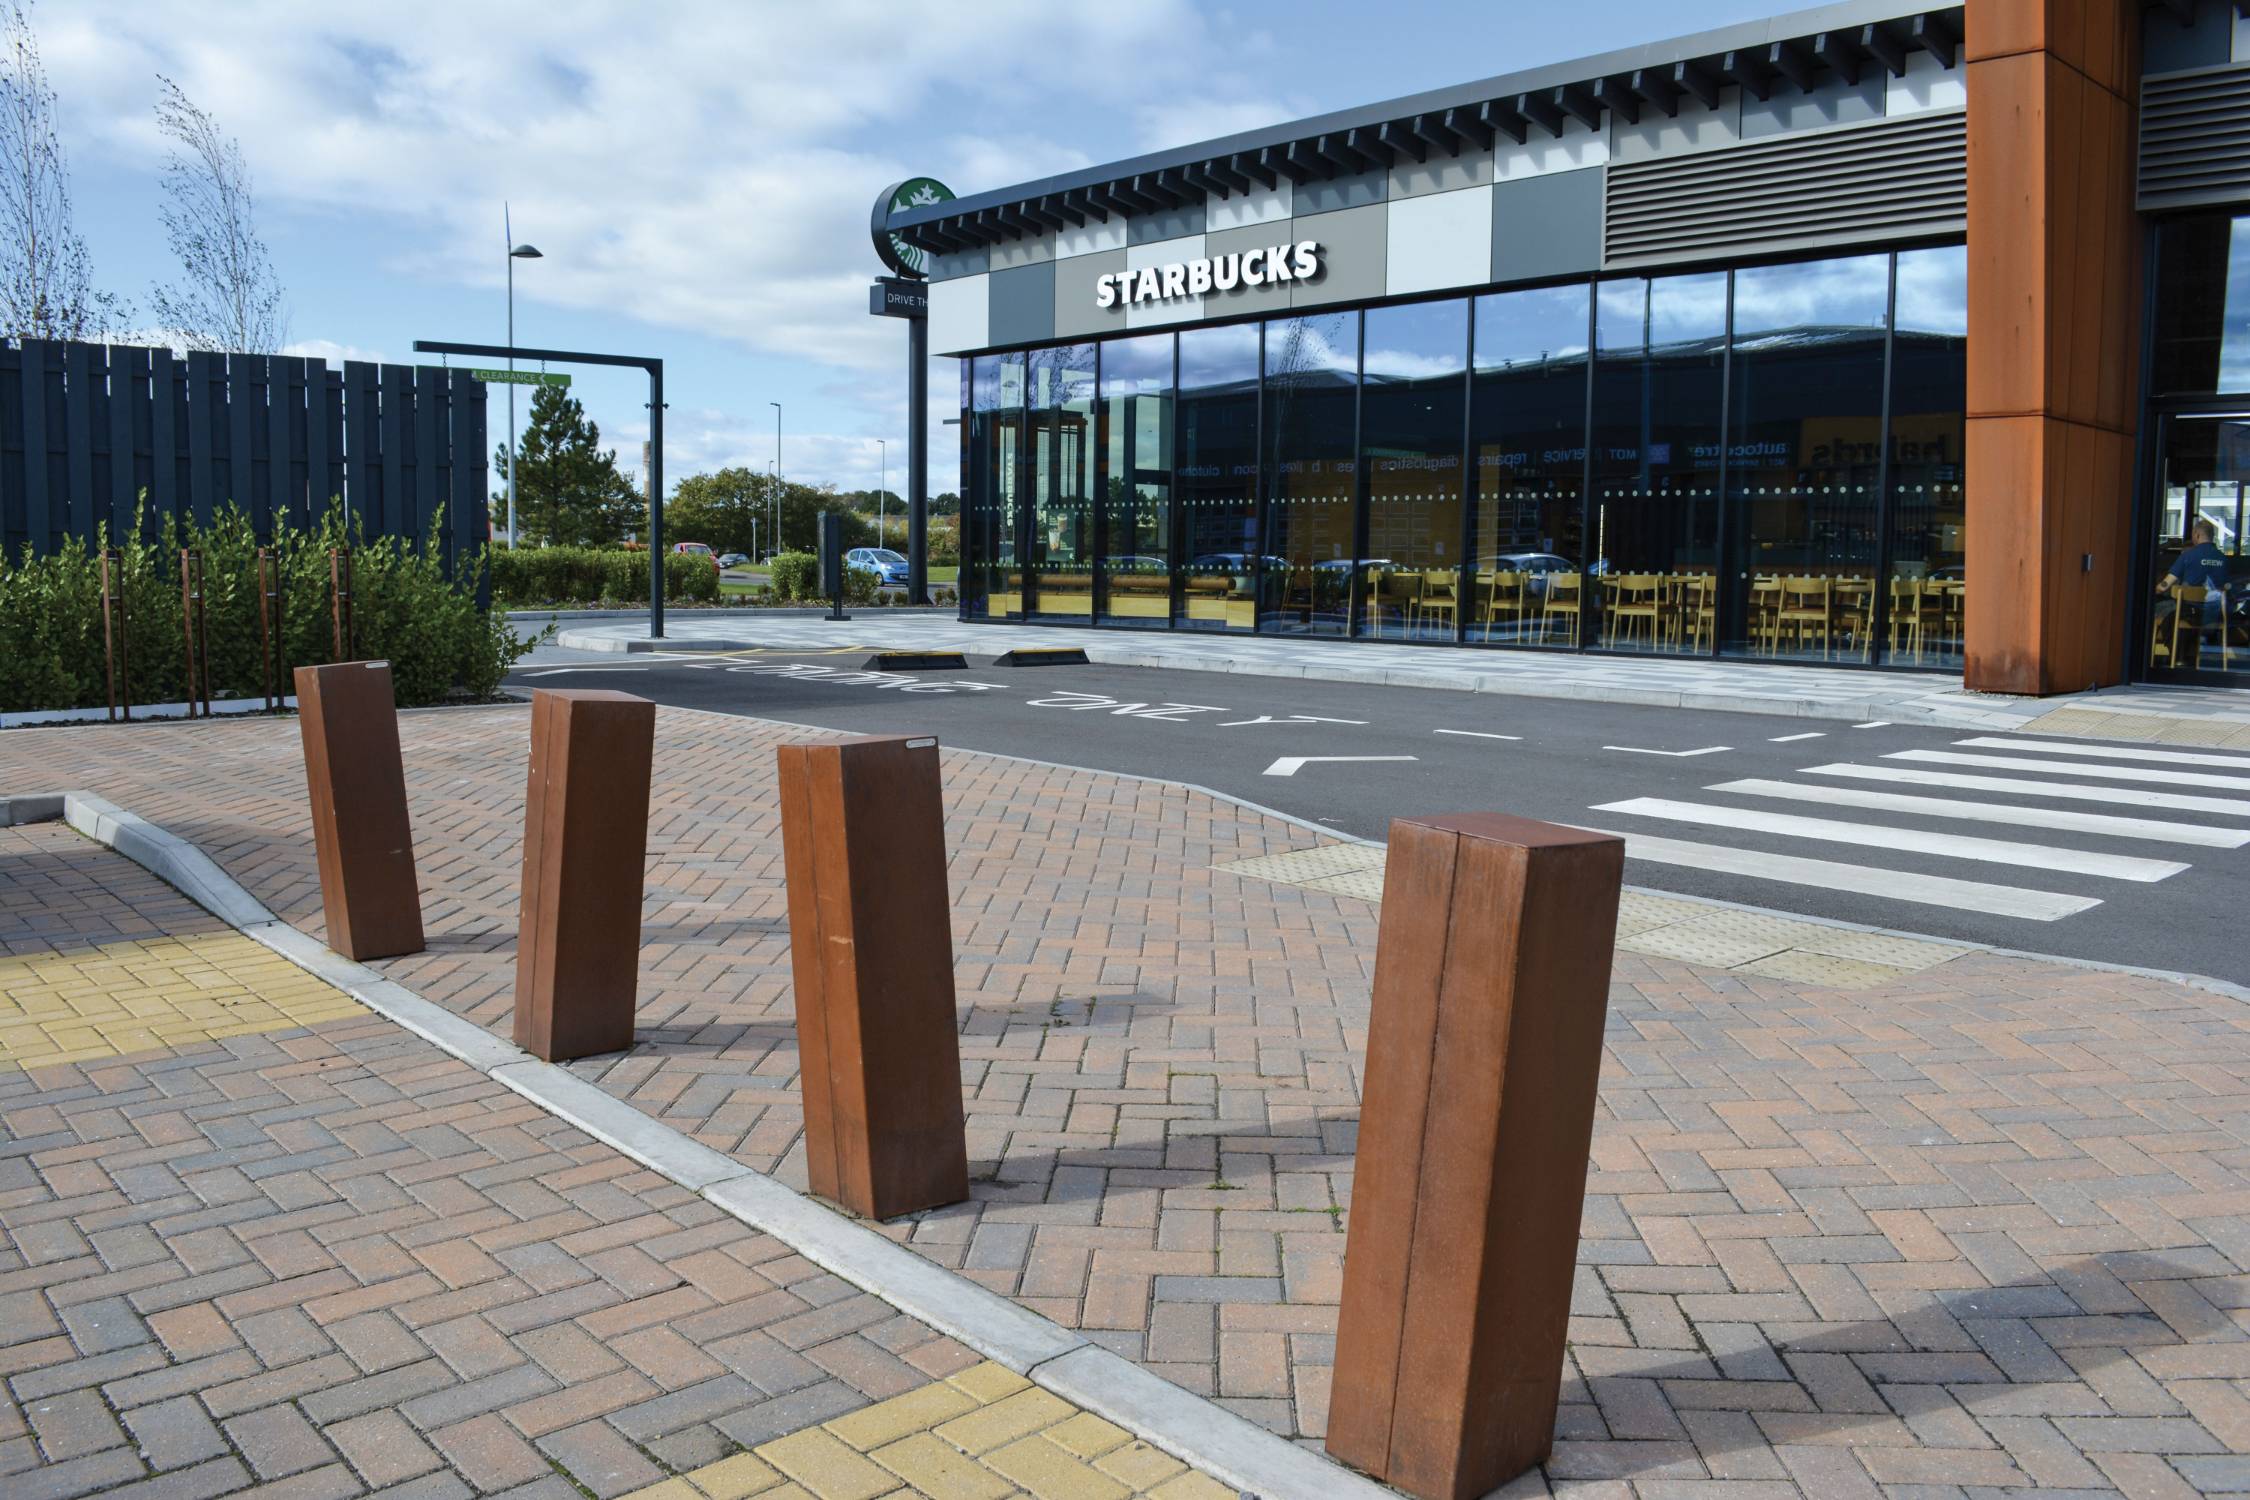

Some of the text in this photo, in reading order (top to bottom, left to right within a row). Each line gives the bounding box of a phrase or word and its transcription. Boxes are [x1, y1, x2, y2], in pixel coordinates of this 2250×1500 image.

[1096, 241, 1318, 308] STARBUCKS
[887, 293, 928, 307] DRIVE TH
[480, 371, 536, 382] CLEARANCE
[2200, 559, 2224, 567] CREW
